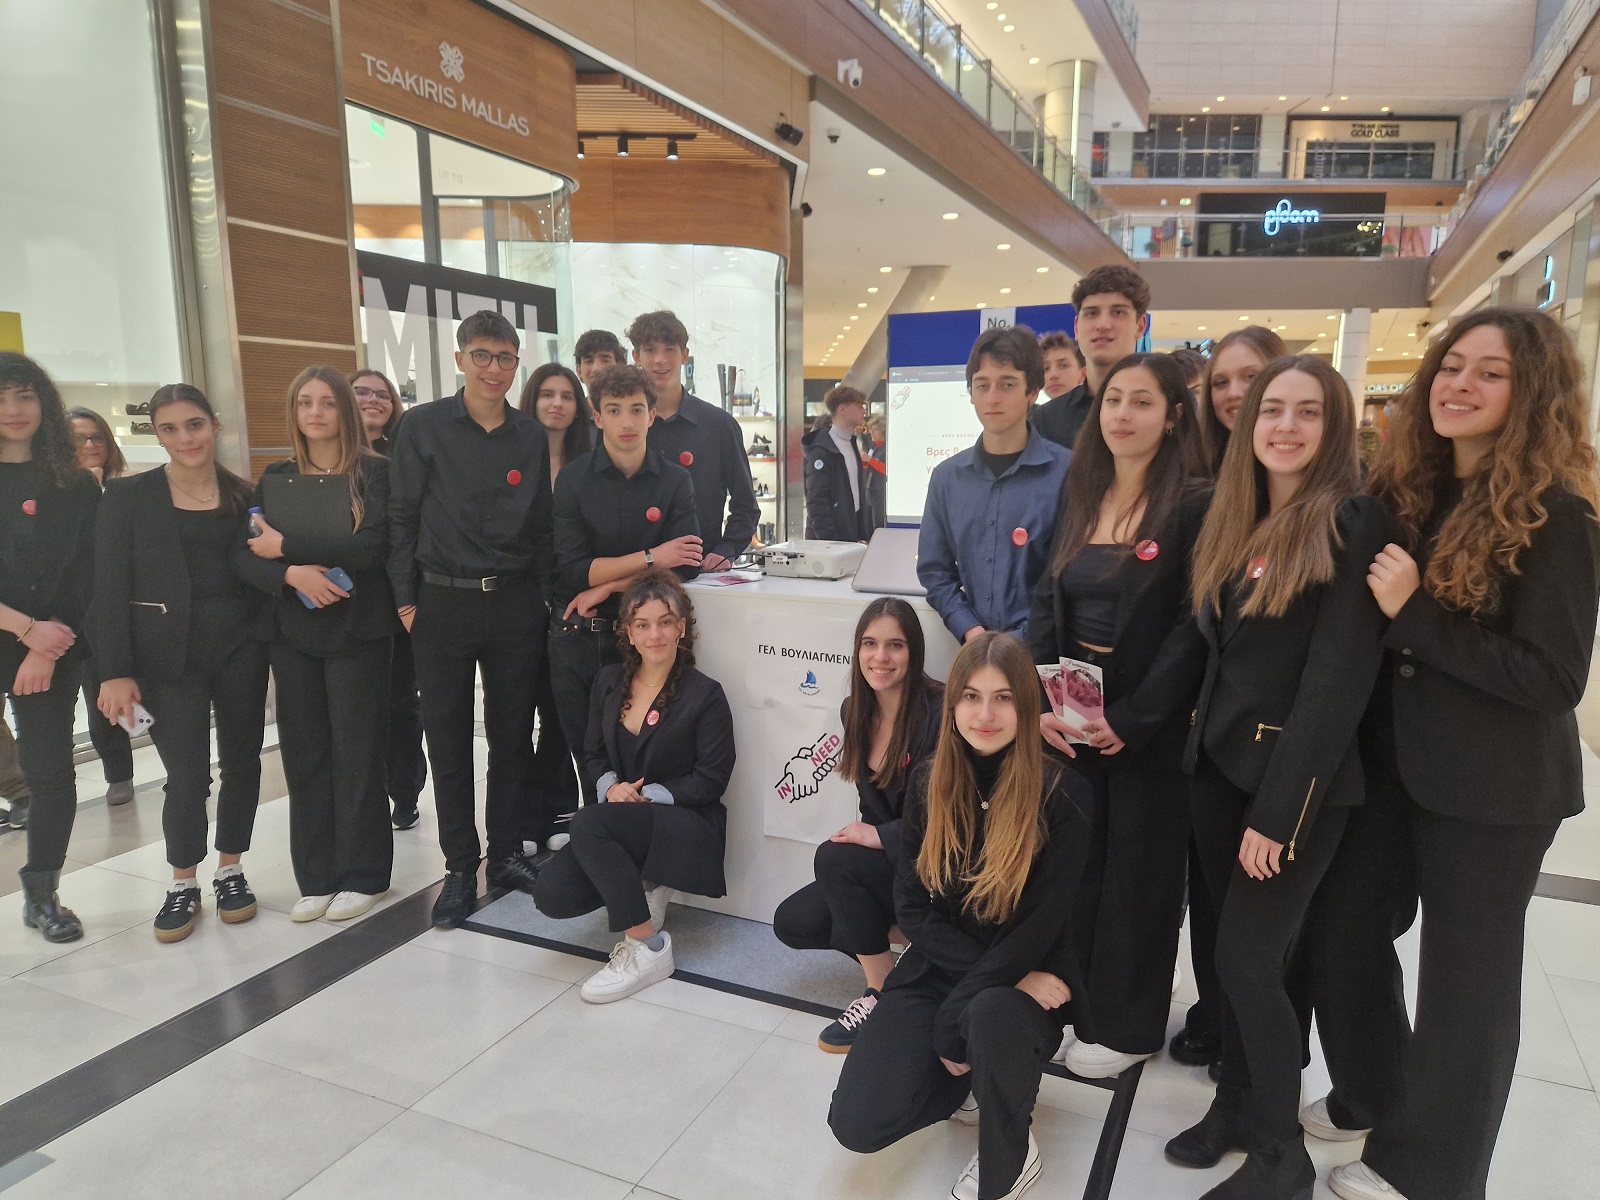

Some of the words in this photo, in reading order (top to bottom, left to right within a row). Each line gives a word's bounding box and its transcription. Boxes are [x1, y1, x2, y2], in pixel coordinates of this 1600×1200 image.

[361, 53, 457, 110] TSAKIRIS
[461, 93, 531, 137] MALLAS
[1350, 129, 1374, 138] GOLD
[758, 644, 776, 656] ΓΕΛ
[781, 647, 854, 665] ΒΟΥΛΙΑΓΜΕΝ
[810, 734, 841, 767] NEED
[777, 782, 792, 800] IN
